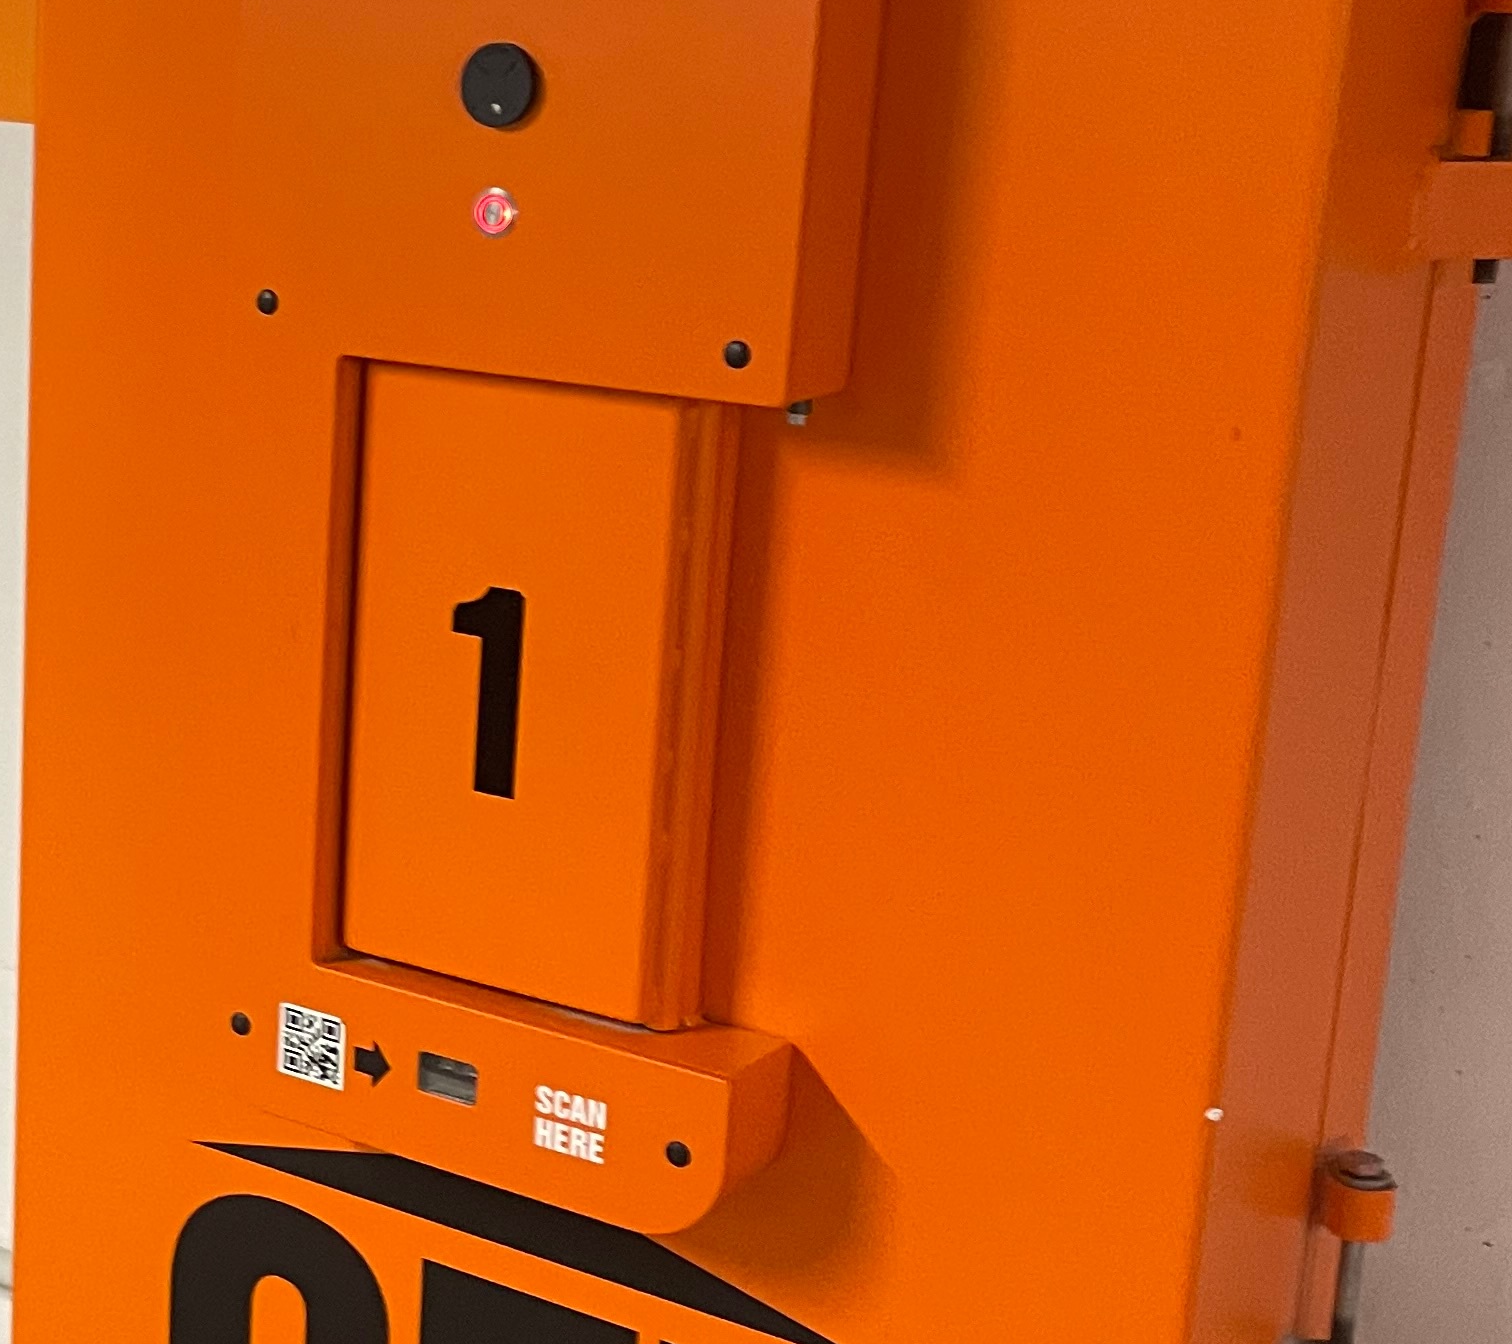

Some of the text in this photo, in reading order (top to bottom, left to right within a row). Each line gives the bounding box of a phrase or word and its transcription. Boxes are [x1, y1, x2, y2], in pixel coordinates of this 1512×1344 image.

[451, 586, 526, 800] 1
[534, 1084, 607, 1131] SCAN
[532, 1115, 606, 1165] HERE
